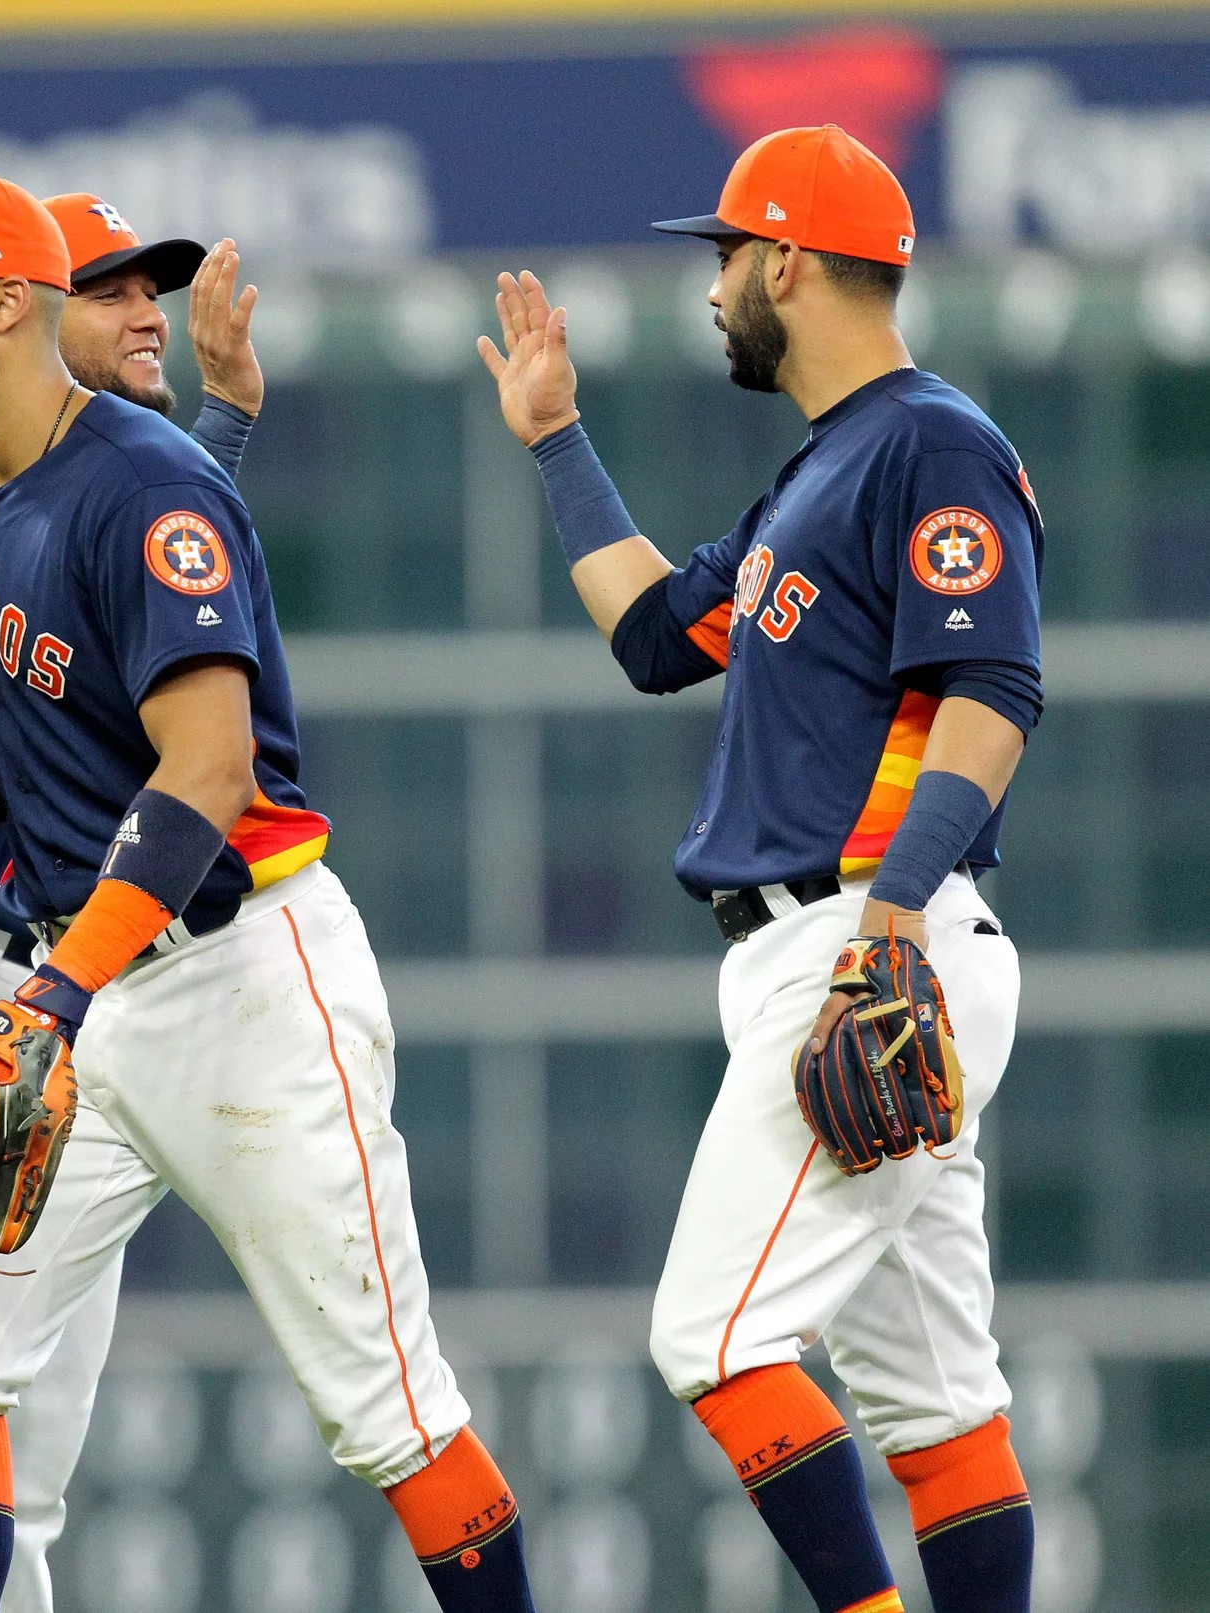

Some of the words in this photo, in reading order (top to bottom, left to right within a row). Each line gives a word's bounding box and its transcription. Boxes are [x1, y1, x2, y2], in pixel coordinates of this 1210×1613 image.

[153, 516, 214, 542] HOUSTON
[920, 512, 988, 541] HOUSTON
[172, 540, 207, 569] H
[938, 537, 973, 568] H
[169, 571, 224, 590] ASTROS
[928, 569, 989, 590] ASTROS
[944, 622, 975, 631] Majestic
[736, 1434, 794, 1476] HTX
[461, 1491, 511, 1536] HTX
